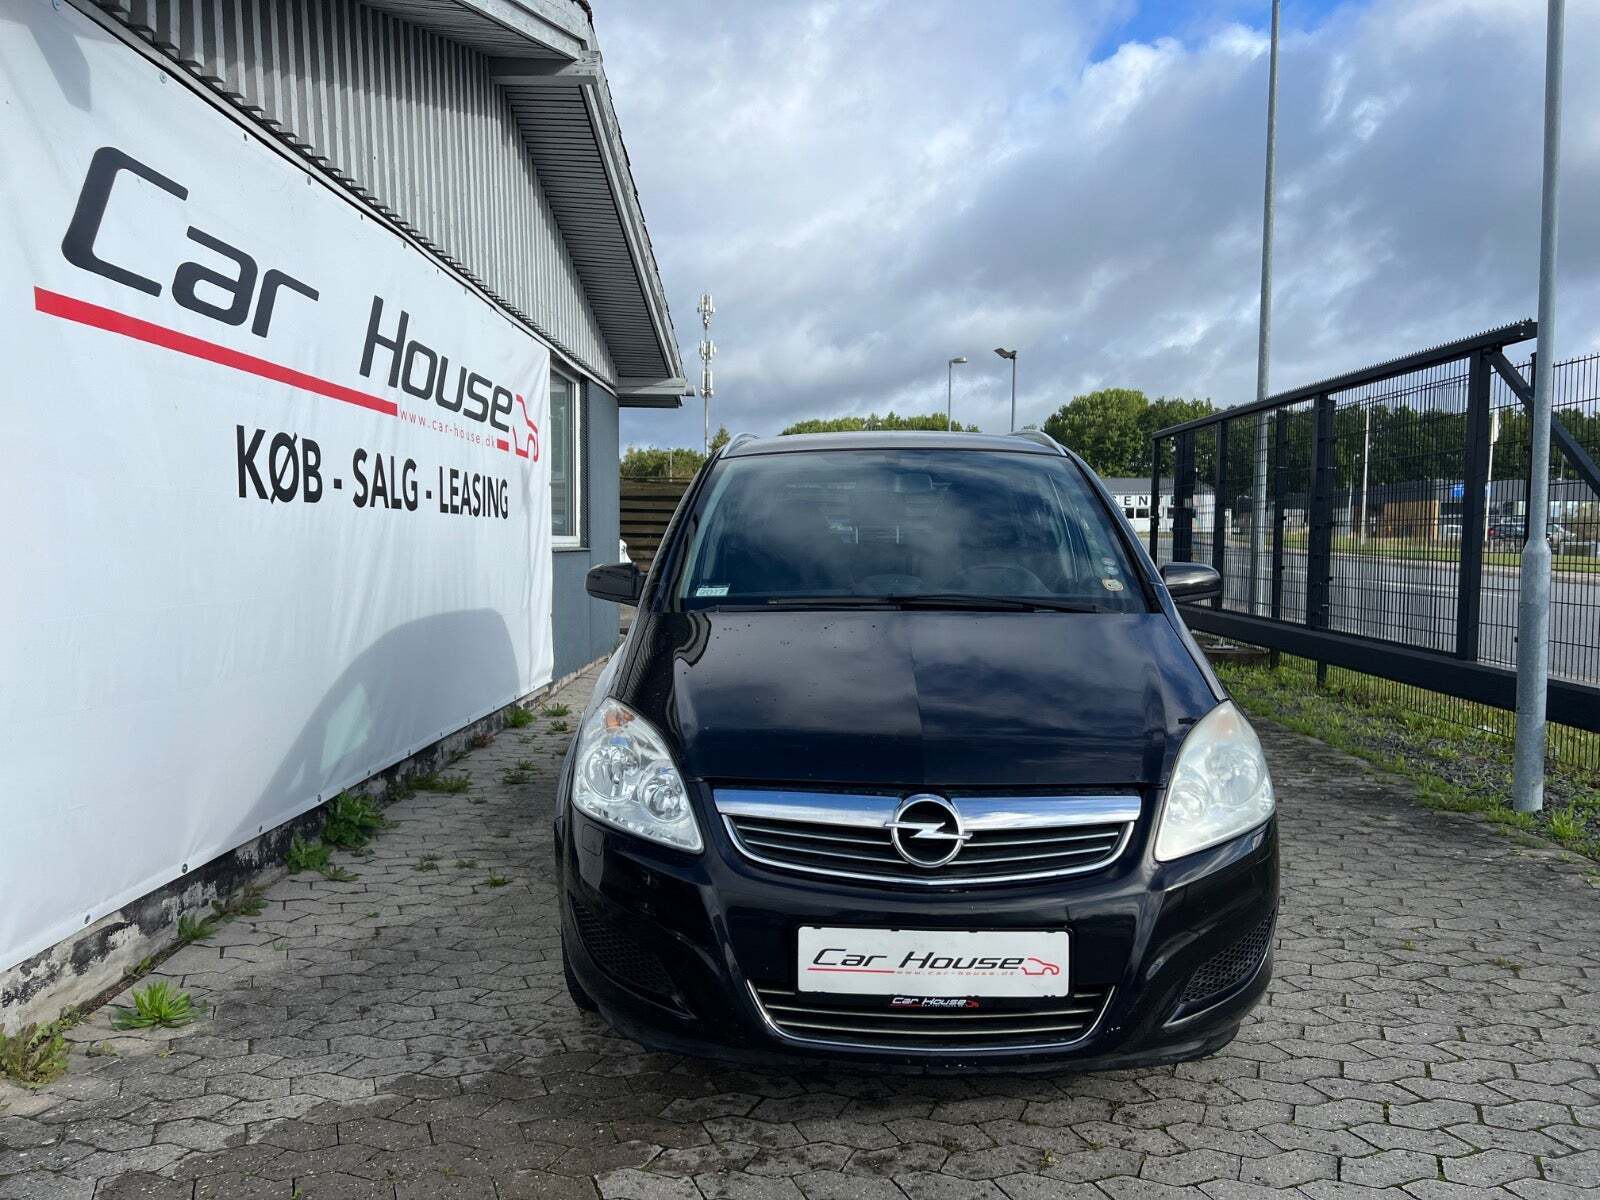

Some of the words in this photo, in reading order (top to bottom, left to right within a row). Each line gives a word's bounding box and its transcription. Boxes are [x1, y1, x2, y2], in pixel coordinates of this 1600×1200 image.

[61, 146, 320, 338] Car
[359, 295, 514, 433] House
[400, 409, 496, 448] www.car-house.dk
[236, 425, 323, 504] KØB
[333, 478, 342, 490] -
[352, 447, 418, 512] SALG
[425, 490, 432, 499] -
[439, 466, 509, 520] LEASING
[812, 948, 888, 968] Car
[898, 951, 1025, 970] House
[891, 997, 919, 1005] Car
[921, 998, 967, 1006] House
